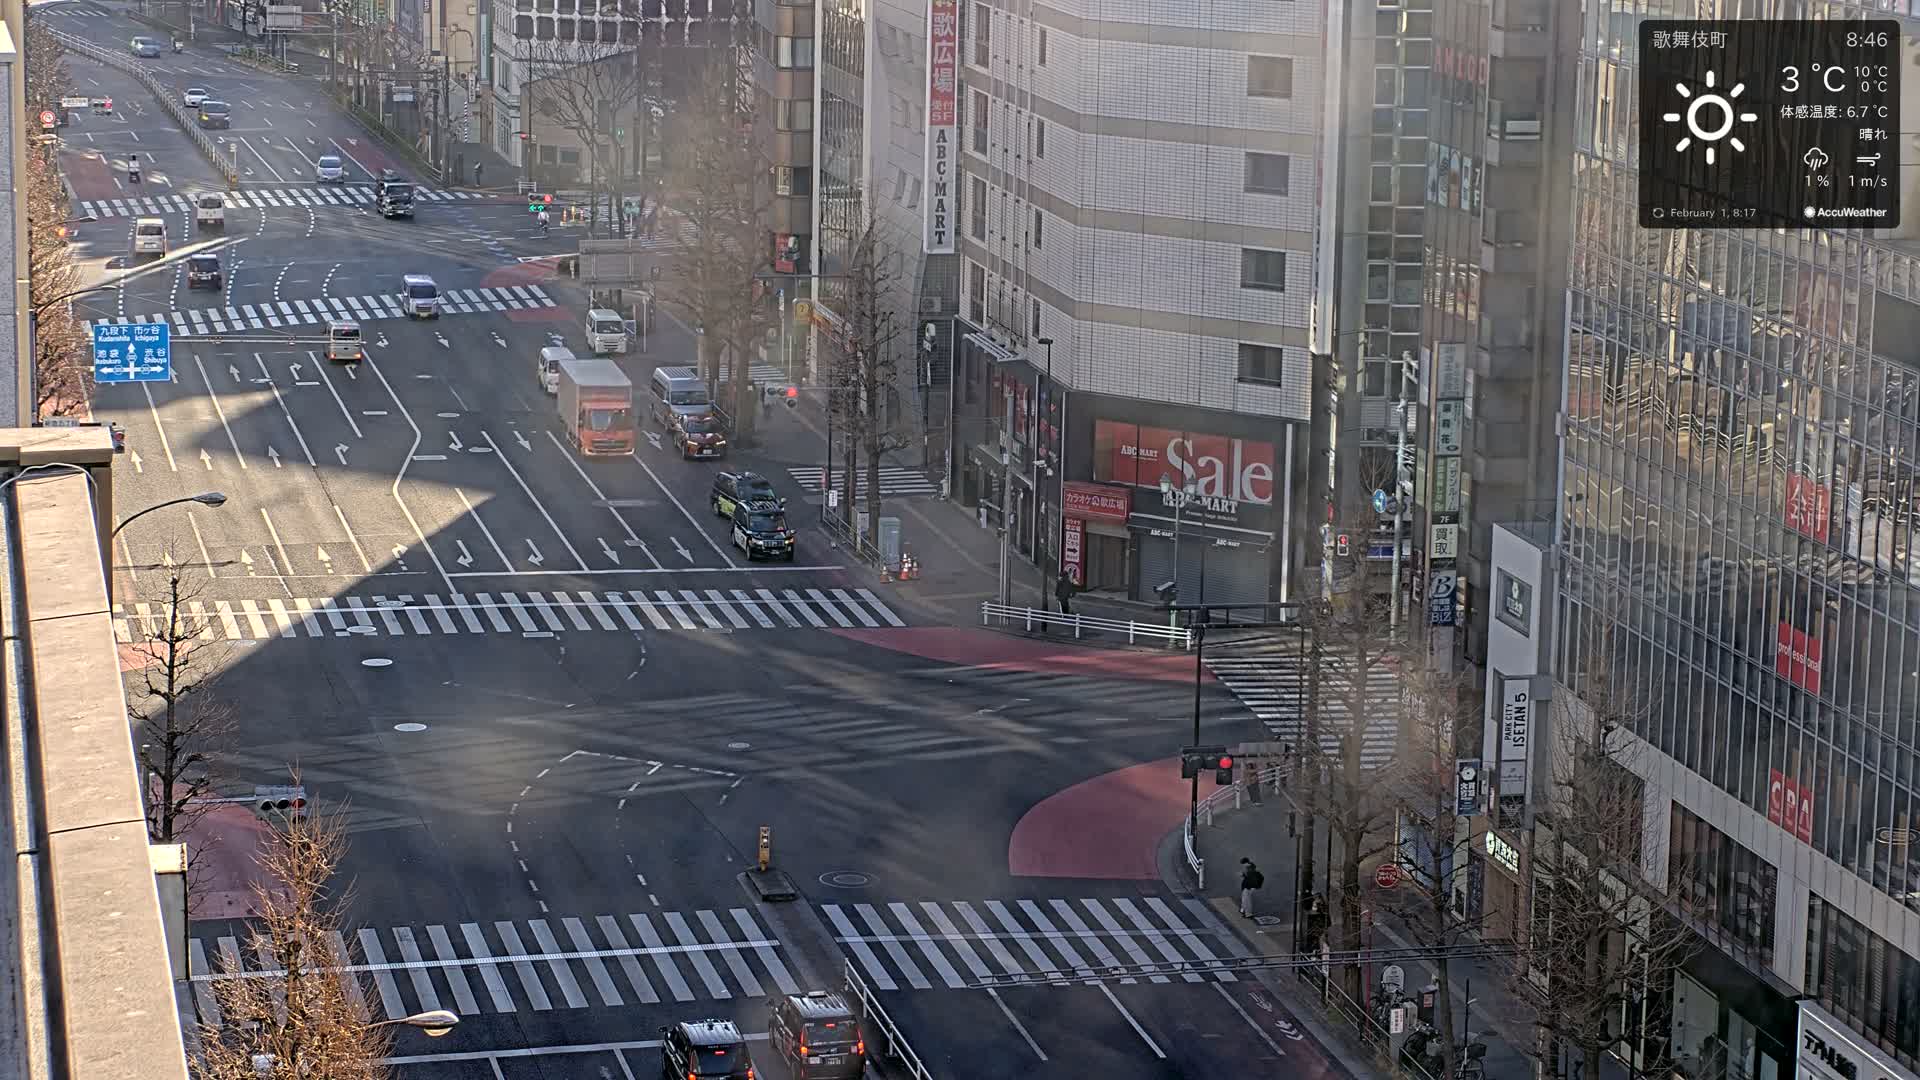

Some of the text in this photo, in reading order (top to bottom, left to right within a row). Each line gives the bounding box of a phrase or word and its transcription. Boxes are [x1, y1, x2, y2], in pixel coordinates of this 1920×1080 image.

[932, 12, 954, 93] 歌広場
[932, 101, 953, 111] 受付
[932, 112, 953, 121] 5F
[100, 326, 128, 336] 九段下
[1121, 438, 1273, 505] ABCMART Sale
[1066, 492, 1090, 504] カラオケ
[1101, 498, 1124, 510] 歌広場
[1440, 515, 1450, 523] 7F
[1434, 528, 1448, 554] 買取
[1504, 703, 1513, 741] PARK CITY
[1513, 692, 1527, 747] ISETAN 5
[1771, 781, 1810, 829] CPA
